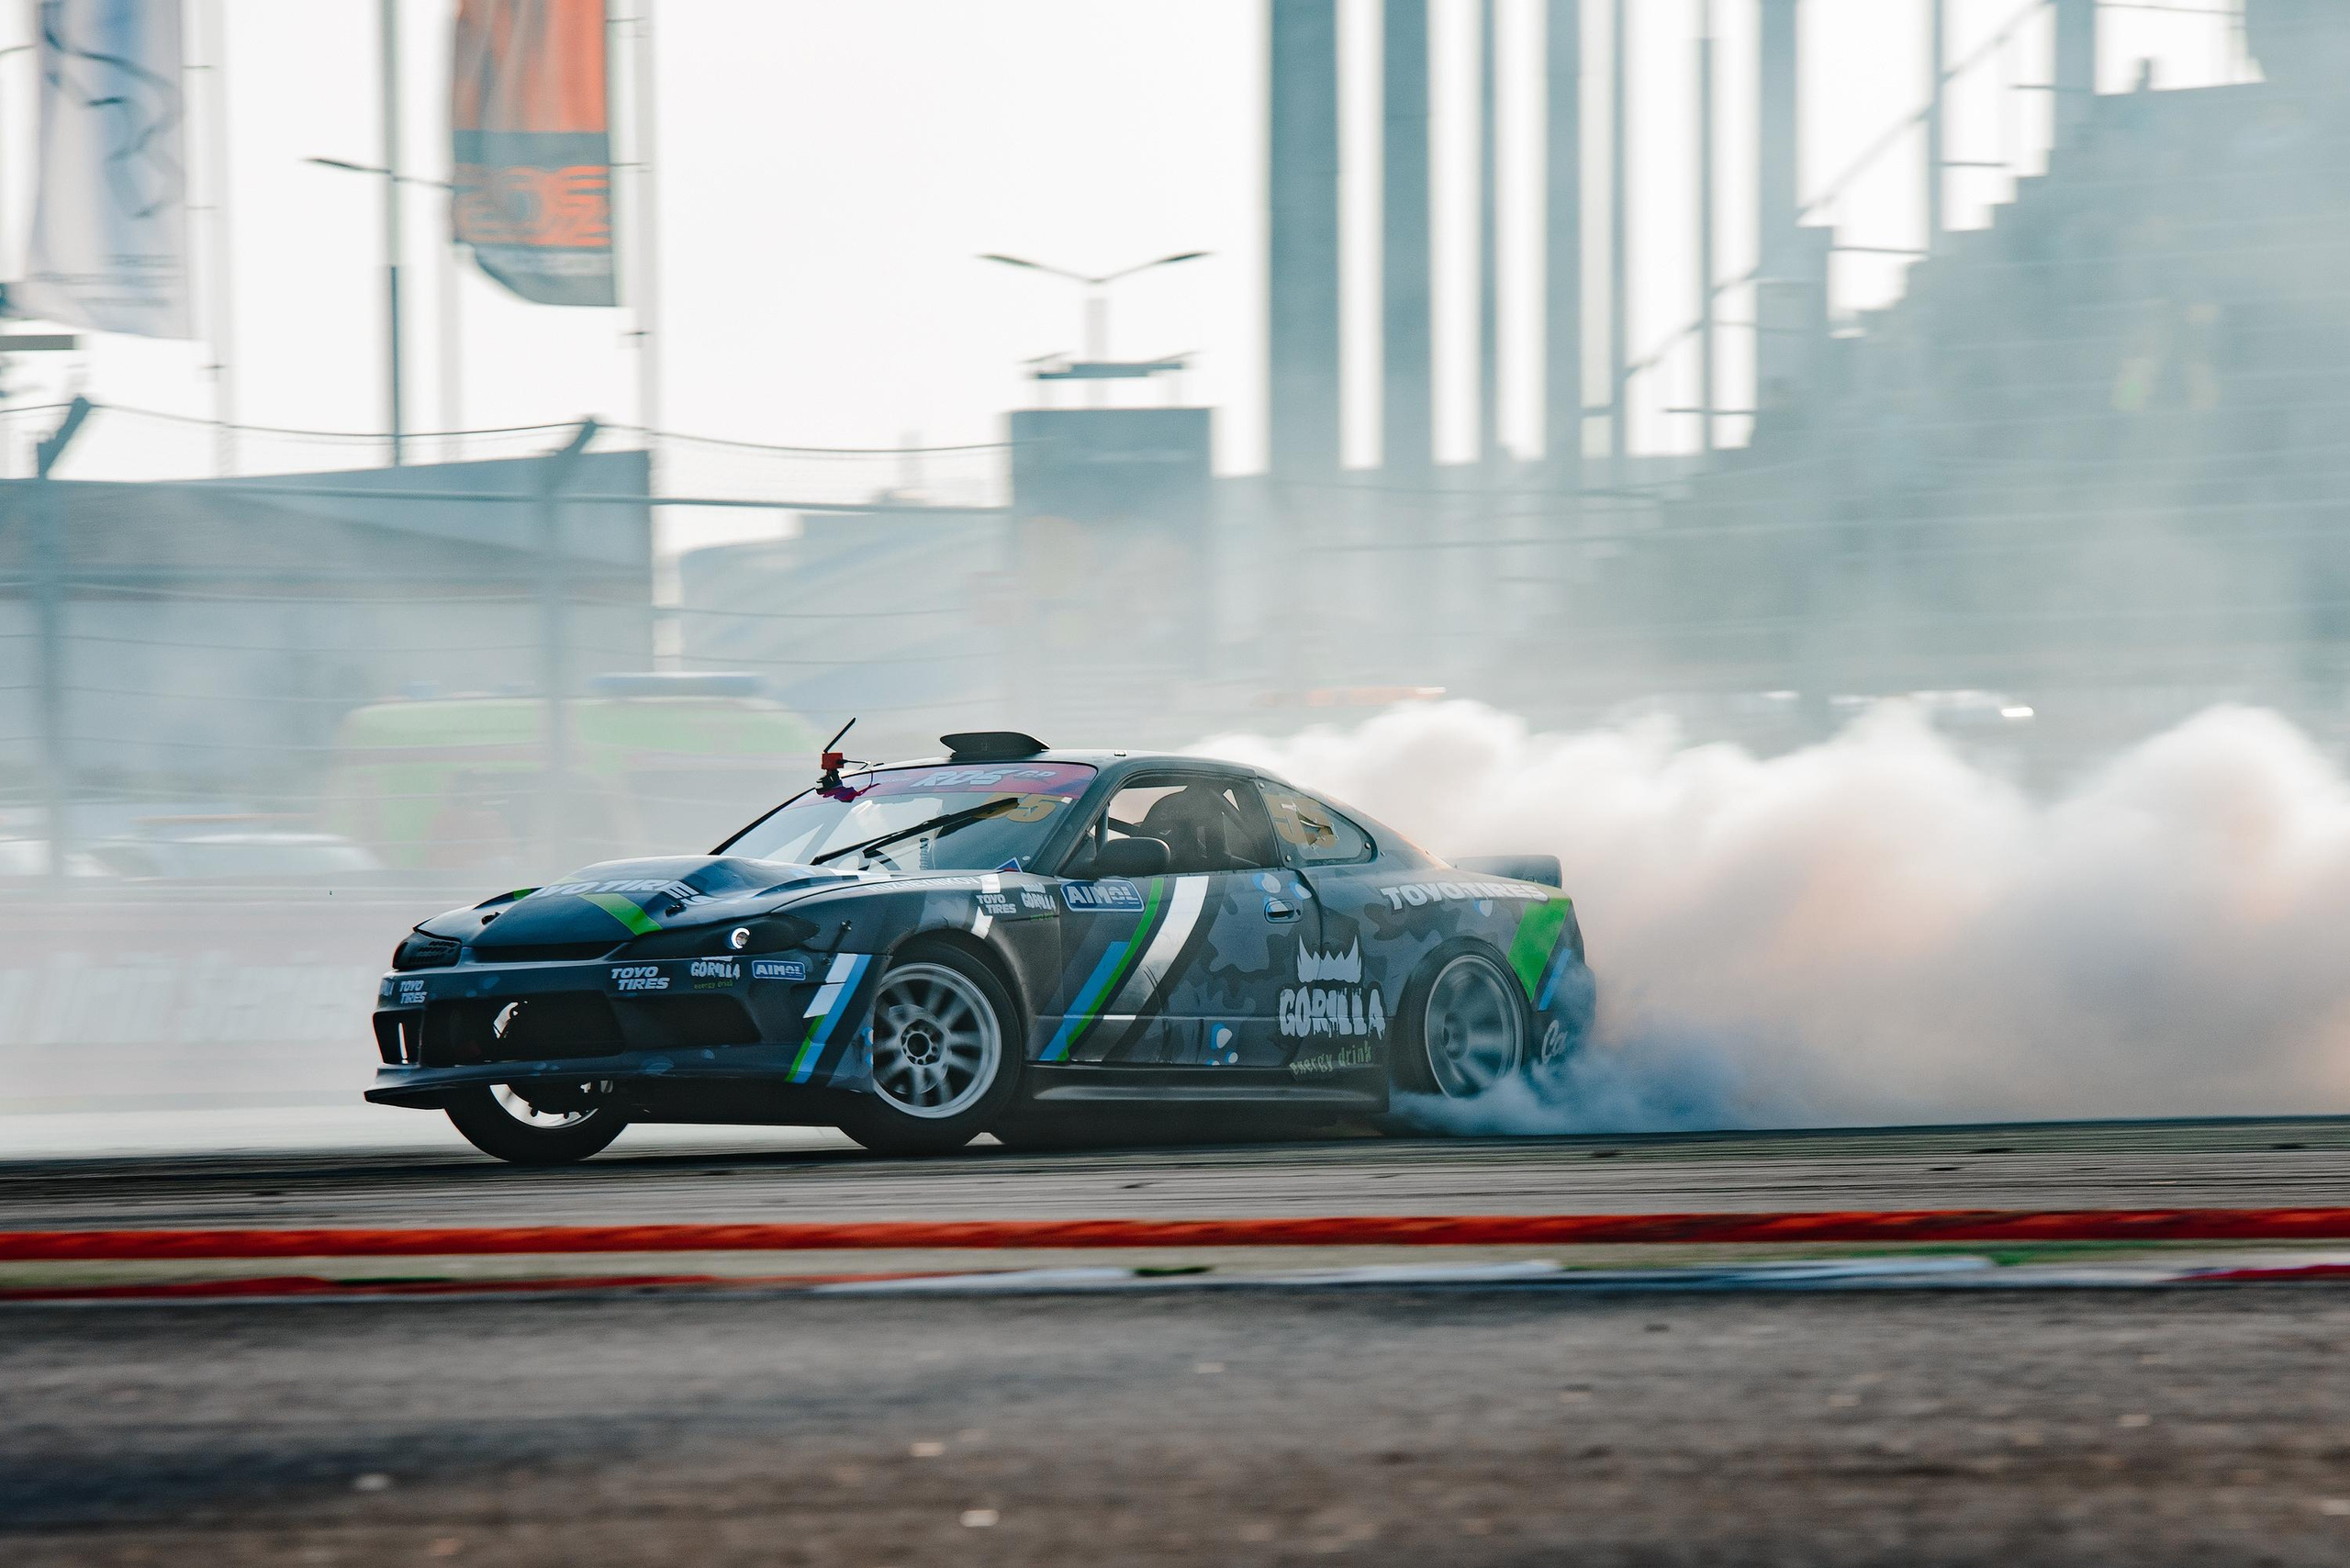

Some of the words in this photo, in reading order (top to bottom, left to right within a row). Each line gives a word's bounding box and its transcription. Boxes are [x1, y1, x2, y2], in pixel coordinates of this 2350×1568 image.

[909, 769, 1021, 788] RDS
[597, 879, 725, 906] TIRES
[977, 894, 1006, 904] TOYO
[1067, 886, 1139, 903] AIMOL
[1380, 882, 1466, 912] TOYO
[1463, 882, 1549, 902] TIRES
[985, 903, 1017, 914] TIRES
[1020, 892, 1057, 913] GORILLA
[611, 967, 659, 979] TOYO
[691, 961, 741, 980] GORILLA
[755, 964, 803, 976] AIMOL
[399, 980, 424, 991] TOYO
[618, 978, 670, 991] TIRES
[400, 991, 428, 1003] TIRES
[1279, 986, 1385, 1040] GORILLA
[1289, 1054, 1334, 1075] energy
[1338, 1040, 1371, 1067] drink
